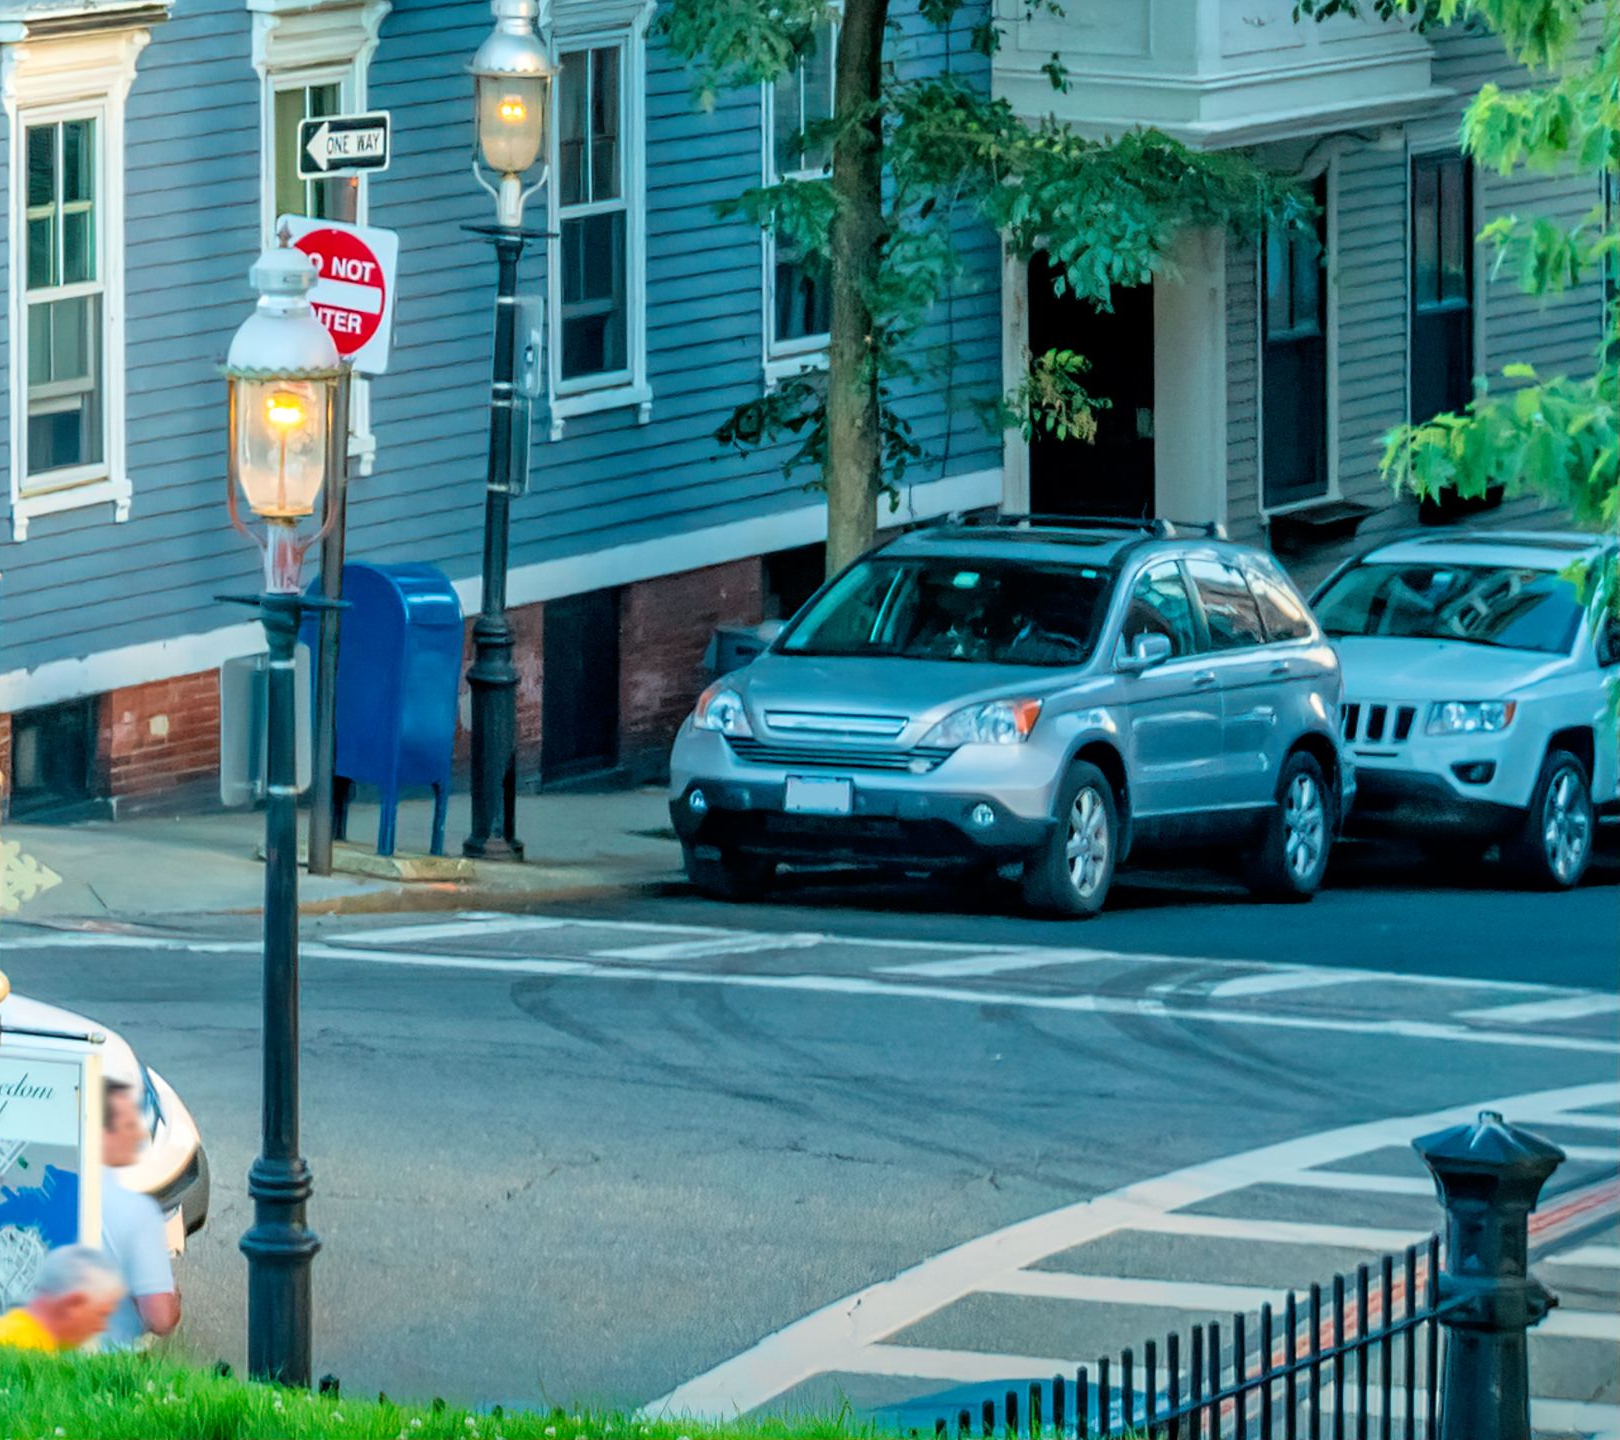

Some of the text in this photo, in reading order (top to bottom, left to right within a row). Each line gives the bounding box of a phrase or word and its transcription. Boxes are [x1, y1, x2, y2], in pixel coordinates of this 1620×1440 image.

[327, 132, 380, 155] ONE WAY
[331, 256, 376, 283] NOT
